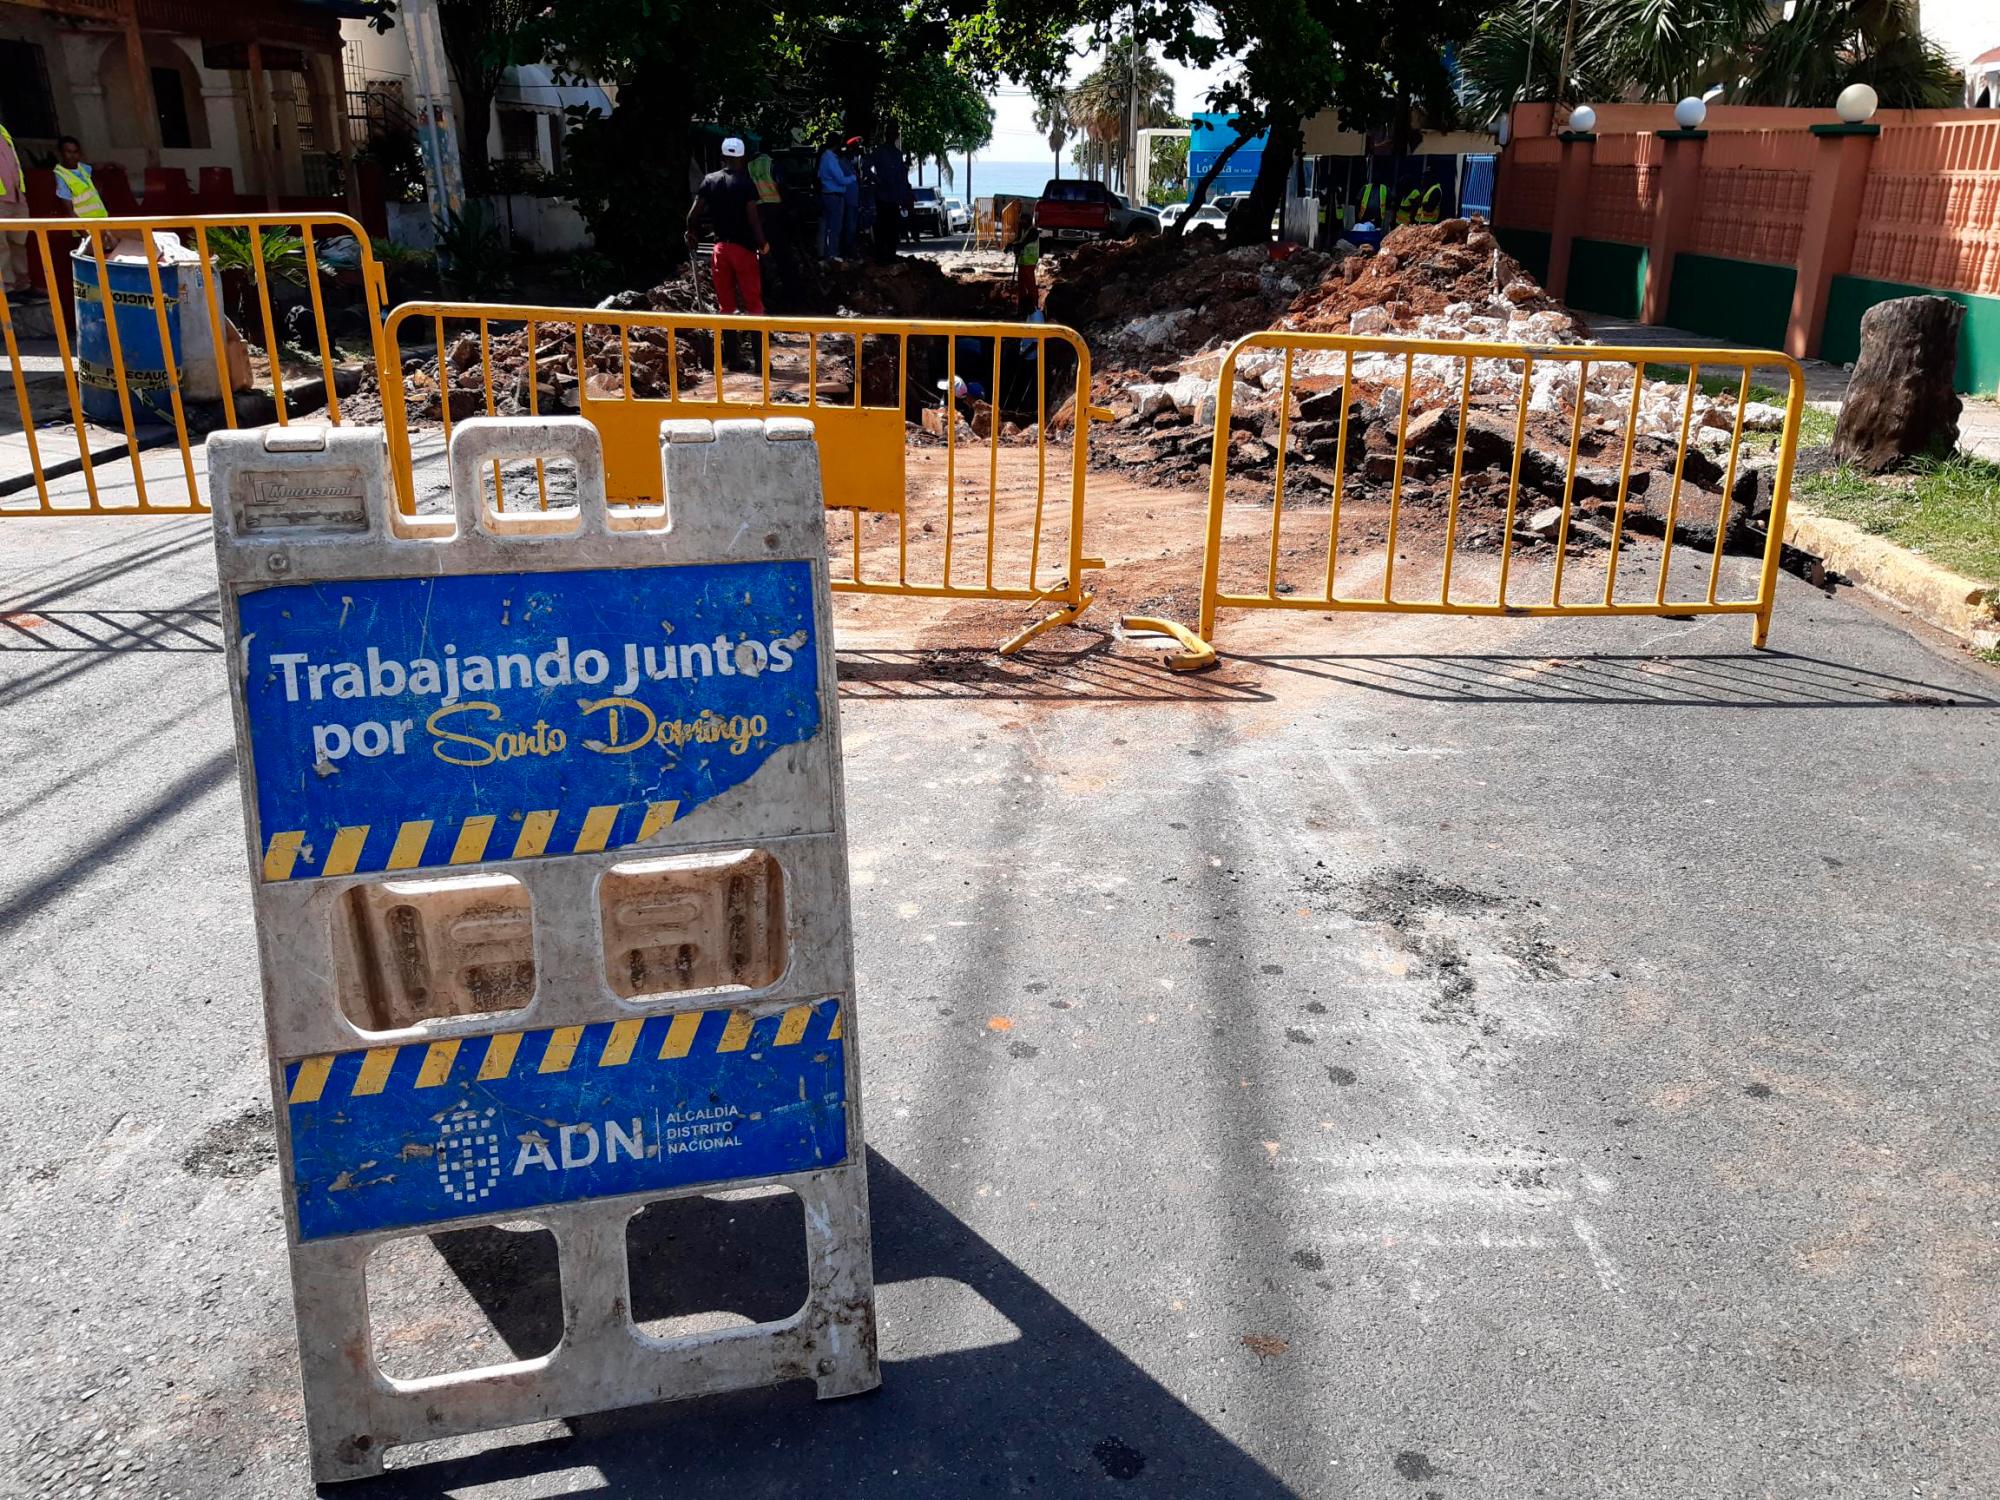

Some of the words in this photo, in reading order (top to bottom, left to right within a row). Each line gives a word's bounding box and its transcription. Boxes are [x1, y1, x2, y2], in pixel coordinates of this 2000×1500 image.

[1196, 163, 1232, 174] Lota
[106, 367, 181, 381] PECAUCN
[270, 637, 610, 706] Trabajando
[613, 634, 794, 695] Juntos
[313, 718, 413, 765] por
[426, 701, 567, 766] Santo
[580, 697, 768, 755] Domingo
[666, 1104, 739, 1124] ALCALDÍA
[666, 1121, 733, 1140] DISTRITO
[512, 1117, 644, 1176] ADN
[667, 1136, 743, 1155] NACIONAL
